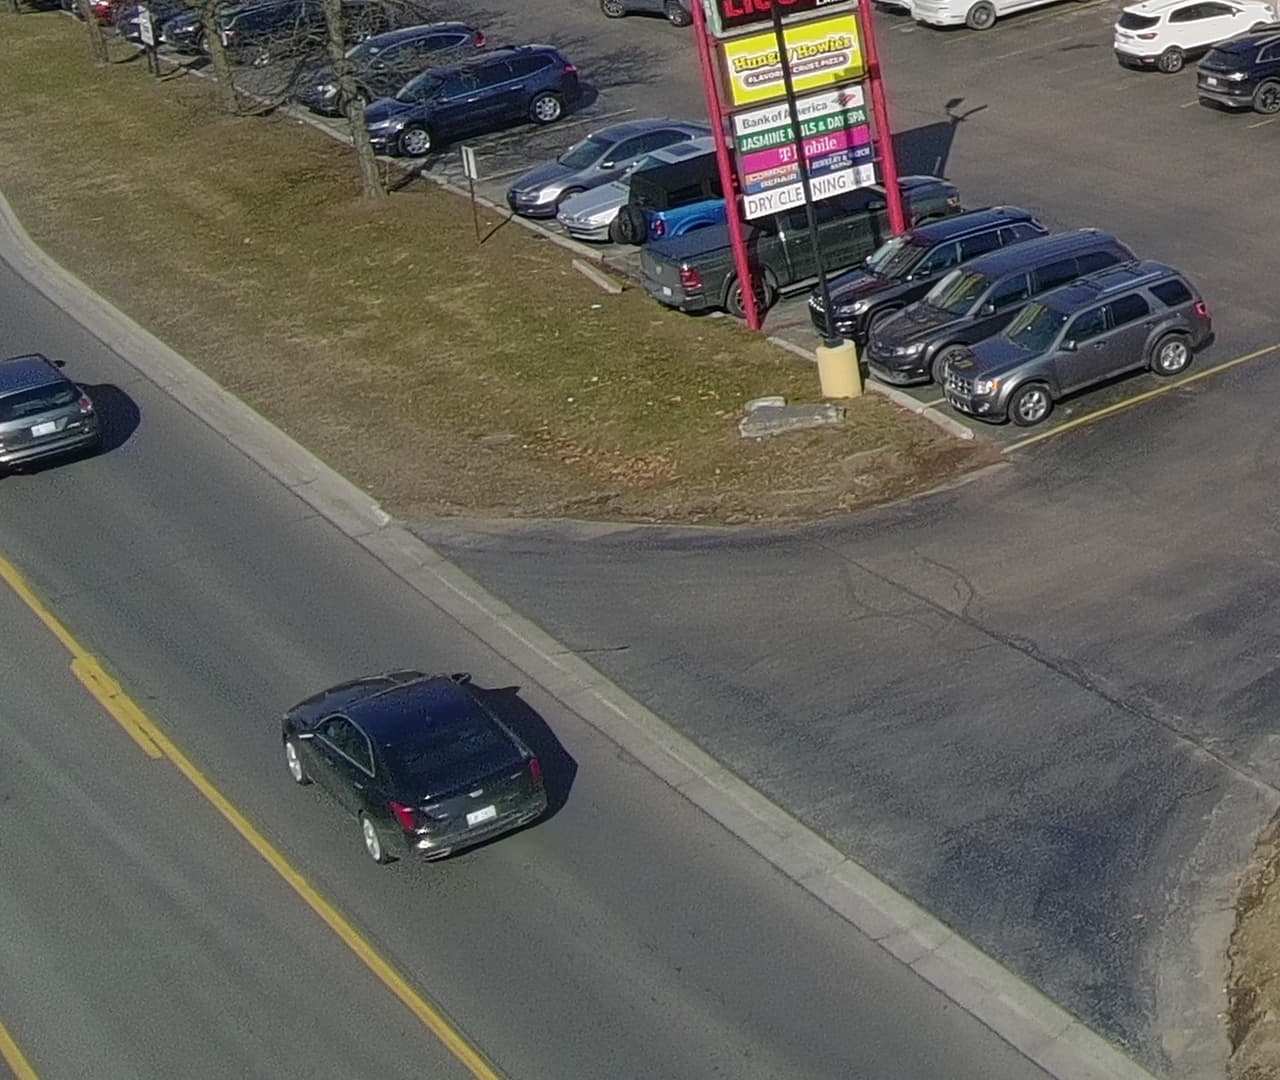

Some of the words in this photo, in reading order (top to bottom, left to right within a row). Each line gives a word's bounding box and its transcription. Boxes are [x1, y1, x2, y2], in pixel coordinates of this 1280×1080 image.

[734, 48, 796, 72] Hungy
[820, 56, 845, 67] PIZZA
[742, 115, 771, 130] Bank
[772, 111, 783, 122] of
[784, 101, 828, 120] Aerica
[741, 128, 786, 151] JASMINE
[788, 120, 817, 140] NILS
[818, 119, 826, 130] &
[827, 113, 845, 129] DAY
[847, 109, 866, 124] SPA
[760, 173, 797, 188] REPAIR
[749, 195, 774, 215] DRY
[778, 175, 846, 205] CLENING
